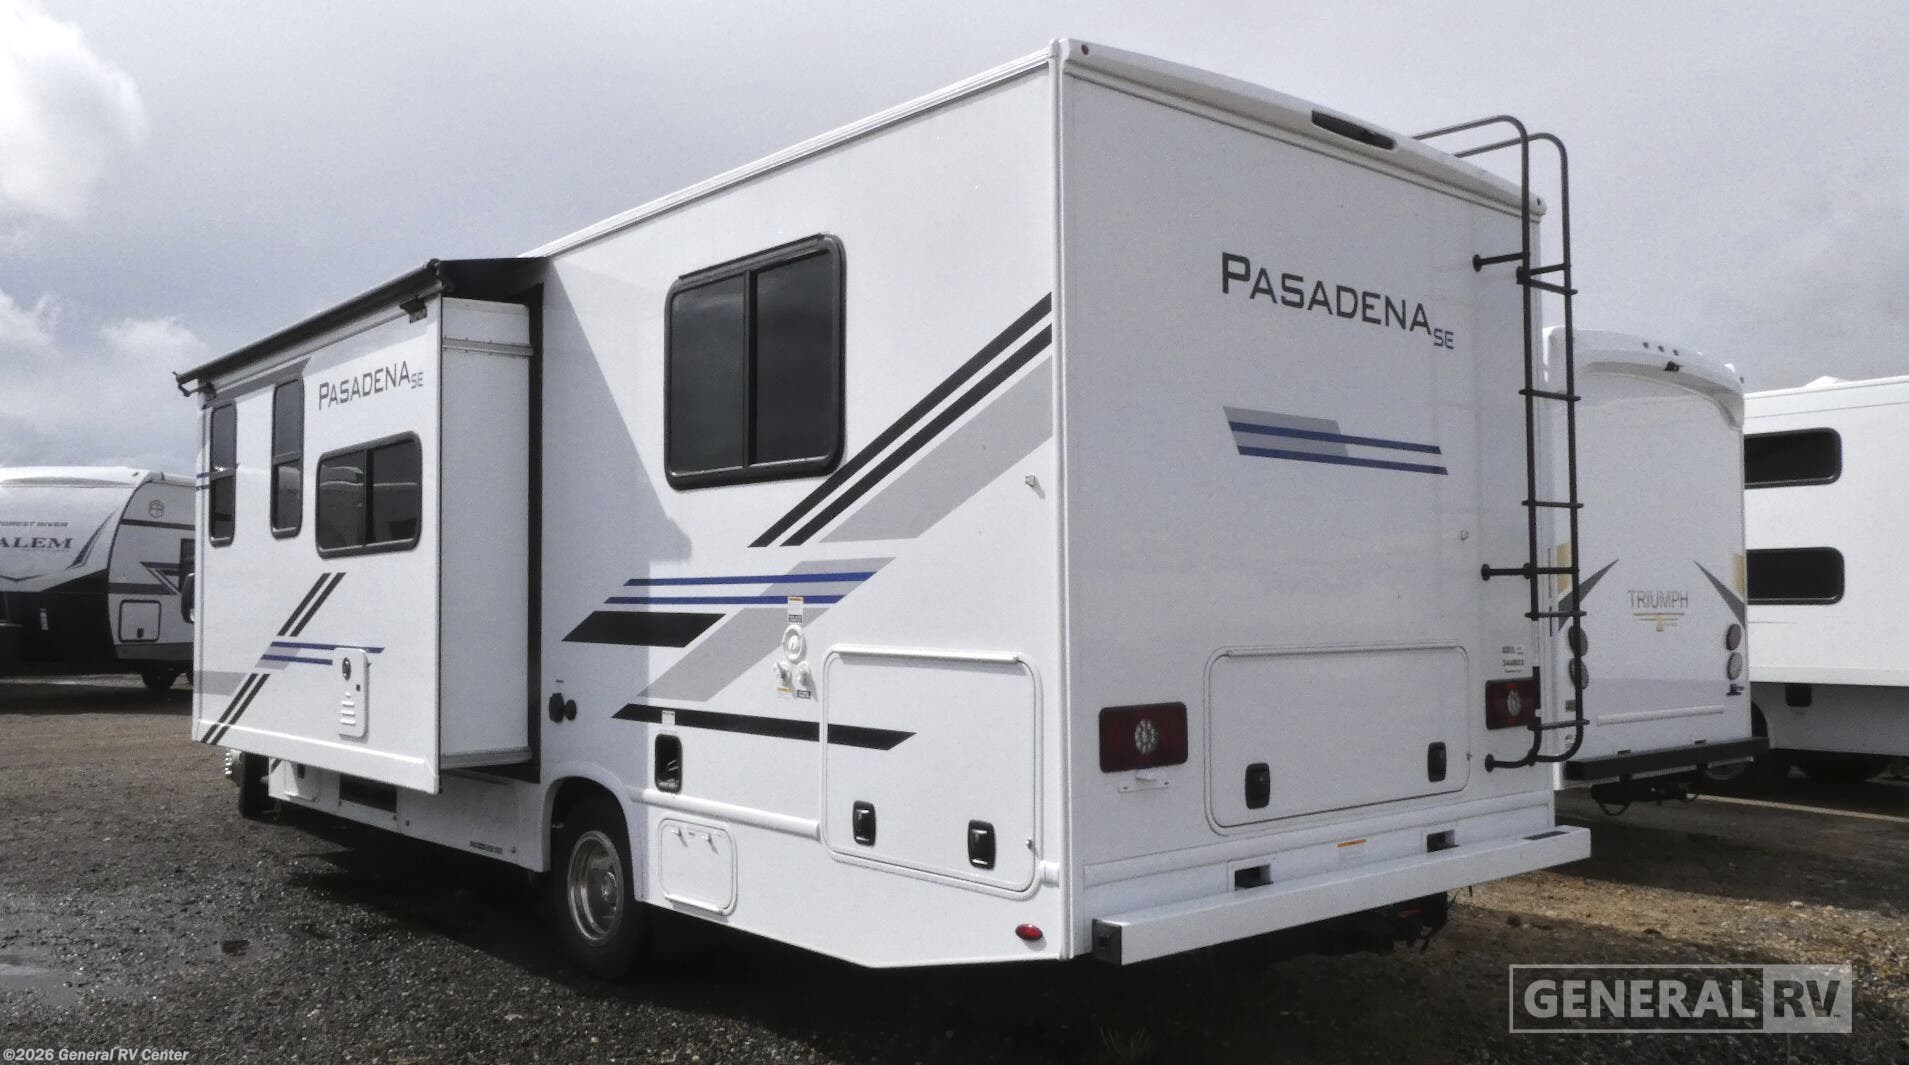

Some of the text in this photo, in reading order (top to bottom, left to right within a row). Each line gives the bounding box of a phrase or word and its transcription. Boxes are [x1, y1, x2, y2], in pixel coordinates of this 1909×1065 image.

[1222, 252, 1454, 349] PASADENA SE
[318, 361, 423, 411] PASADENA SE
[0, 536, 73, 548] ALEM
[1628, 590, 1689, 608] TRIUMPH
